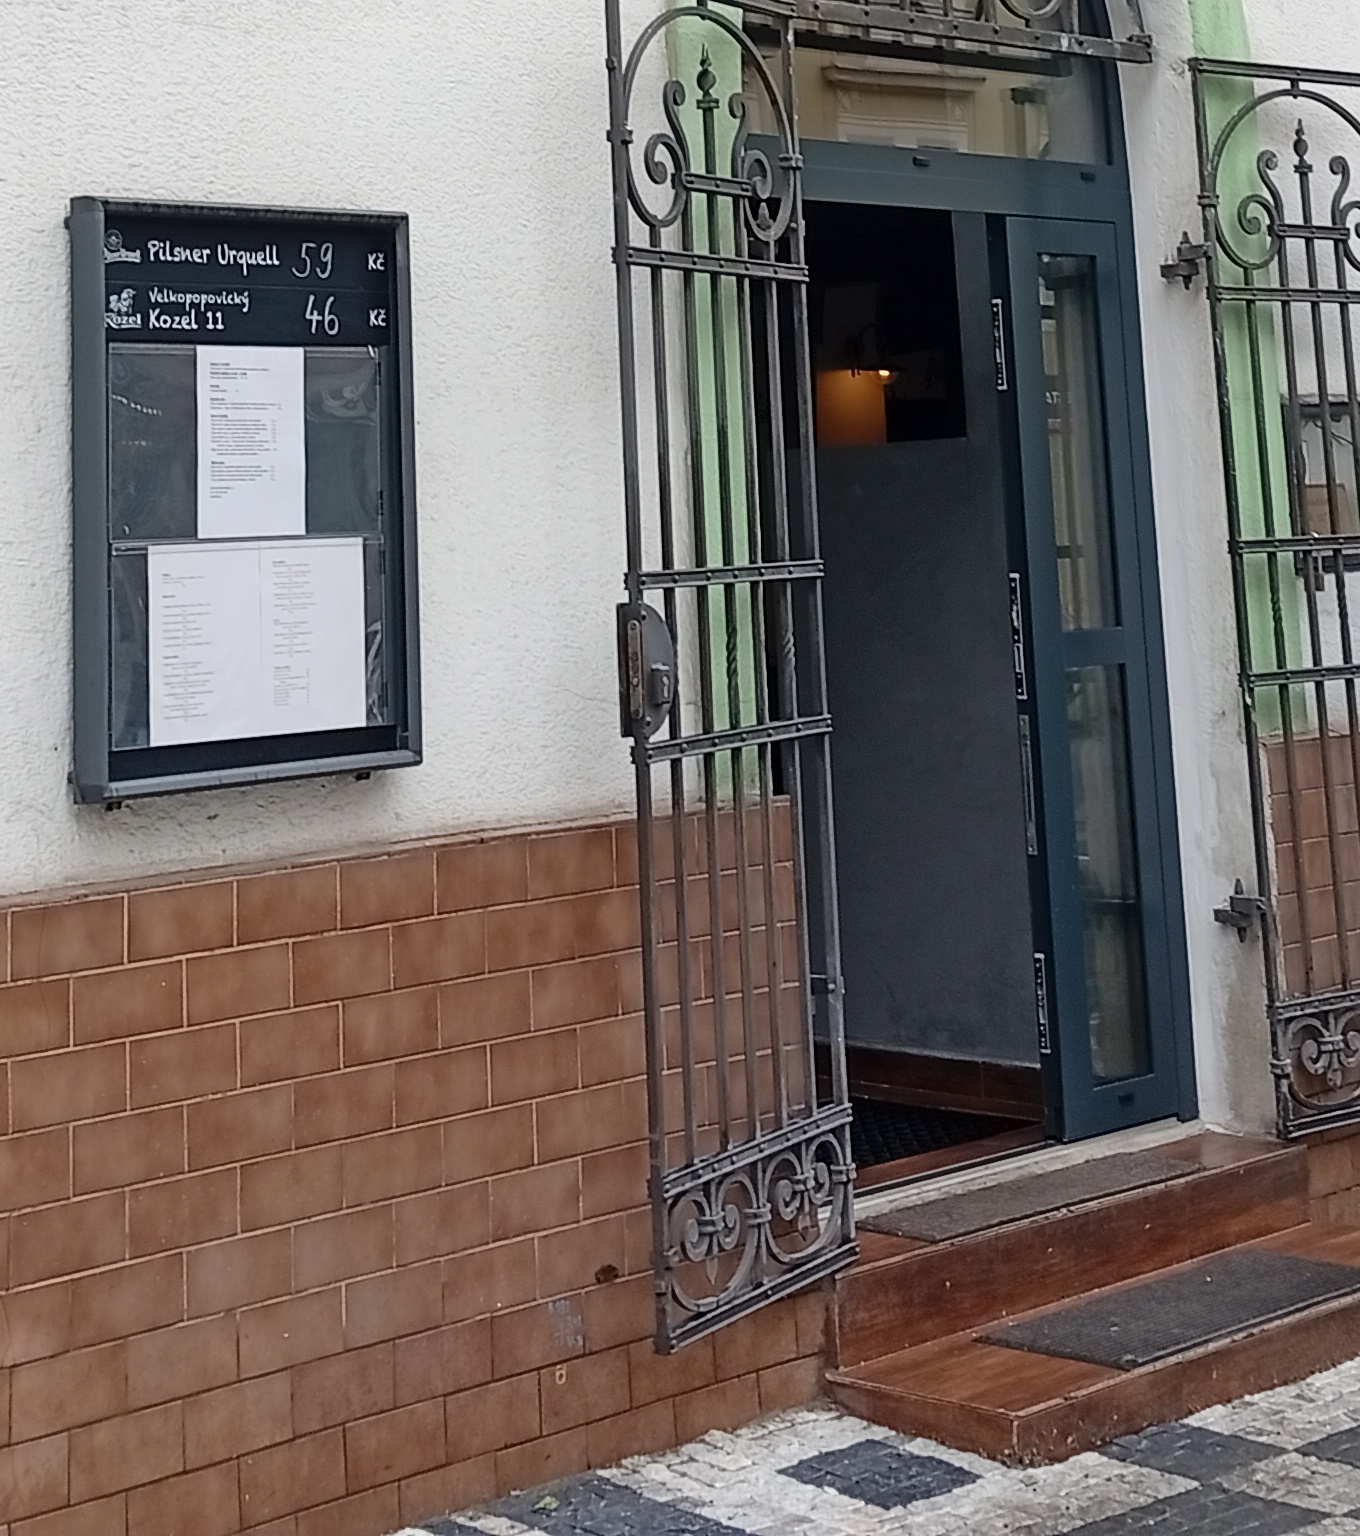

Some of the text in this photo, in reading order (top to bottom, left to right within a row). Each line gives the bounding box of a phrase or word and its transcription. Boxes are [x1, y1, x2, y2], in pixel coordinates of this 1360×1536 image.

[148, 240, 211, 265] Pilsner
[217, 244, 280, 276] Urquell
[291, 242, 334, 279] 59
[367, 252, 386, 272] Kč
[148, 288, 250, 313] Velkopopovický
[148, 294, 387, 336] Kozel 11 46 Kč
